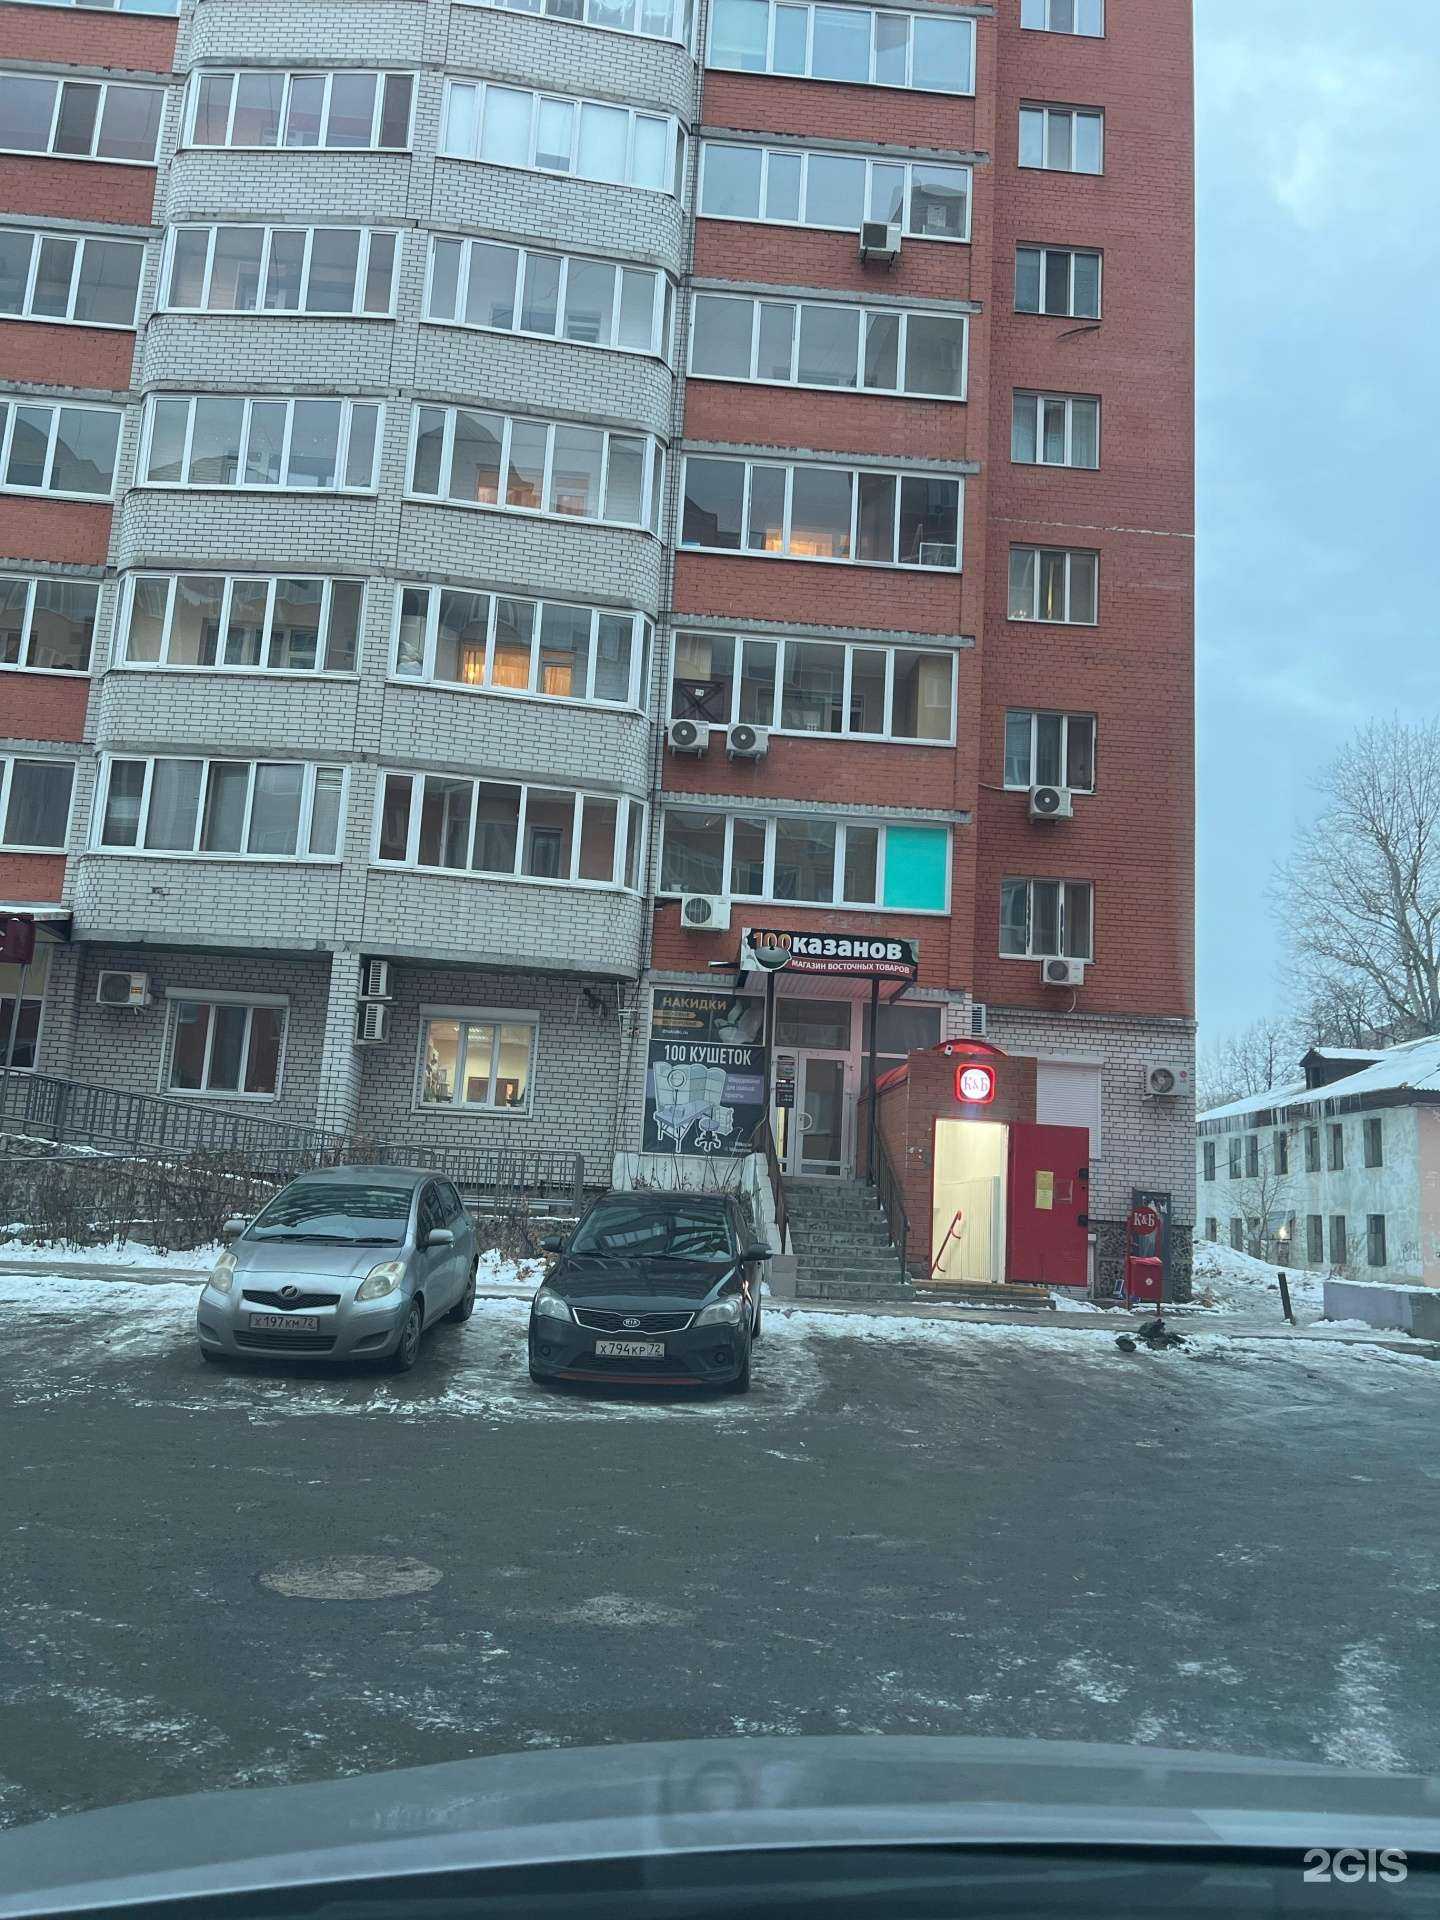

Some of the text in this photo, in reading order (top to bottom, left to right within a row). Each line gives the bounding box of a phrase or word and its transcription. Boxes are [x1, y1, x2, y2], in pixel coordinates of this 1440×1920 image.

[791, 960, 910, 974] МАГАЗИН ВОСТОЧНЫХ ТОВАРОВ
[662, 996, 727, 1011] НАКИДКИ
[664, 1044, 752, 1066] 100 КУШЕТОК
[649, 1343, 661, 1353] 72
